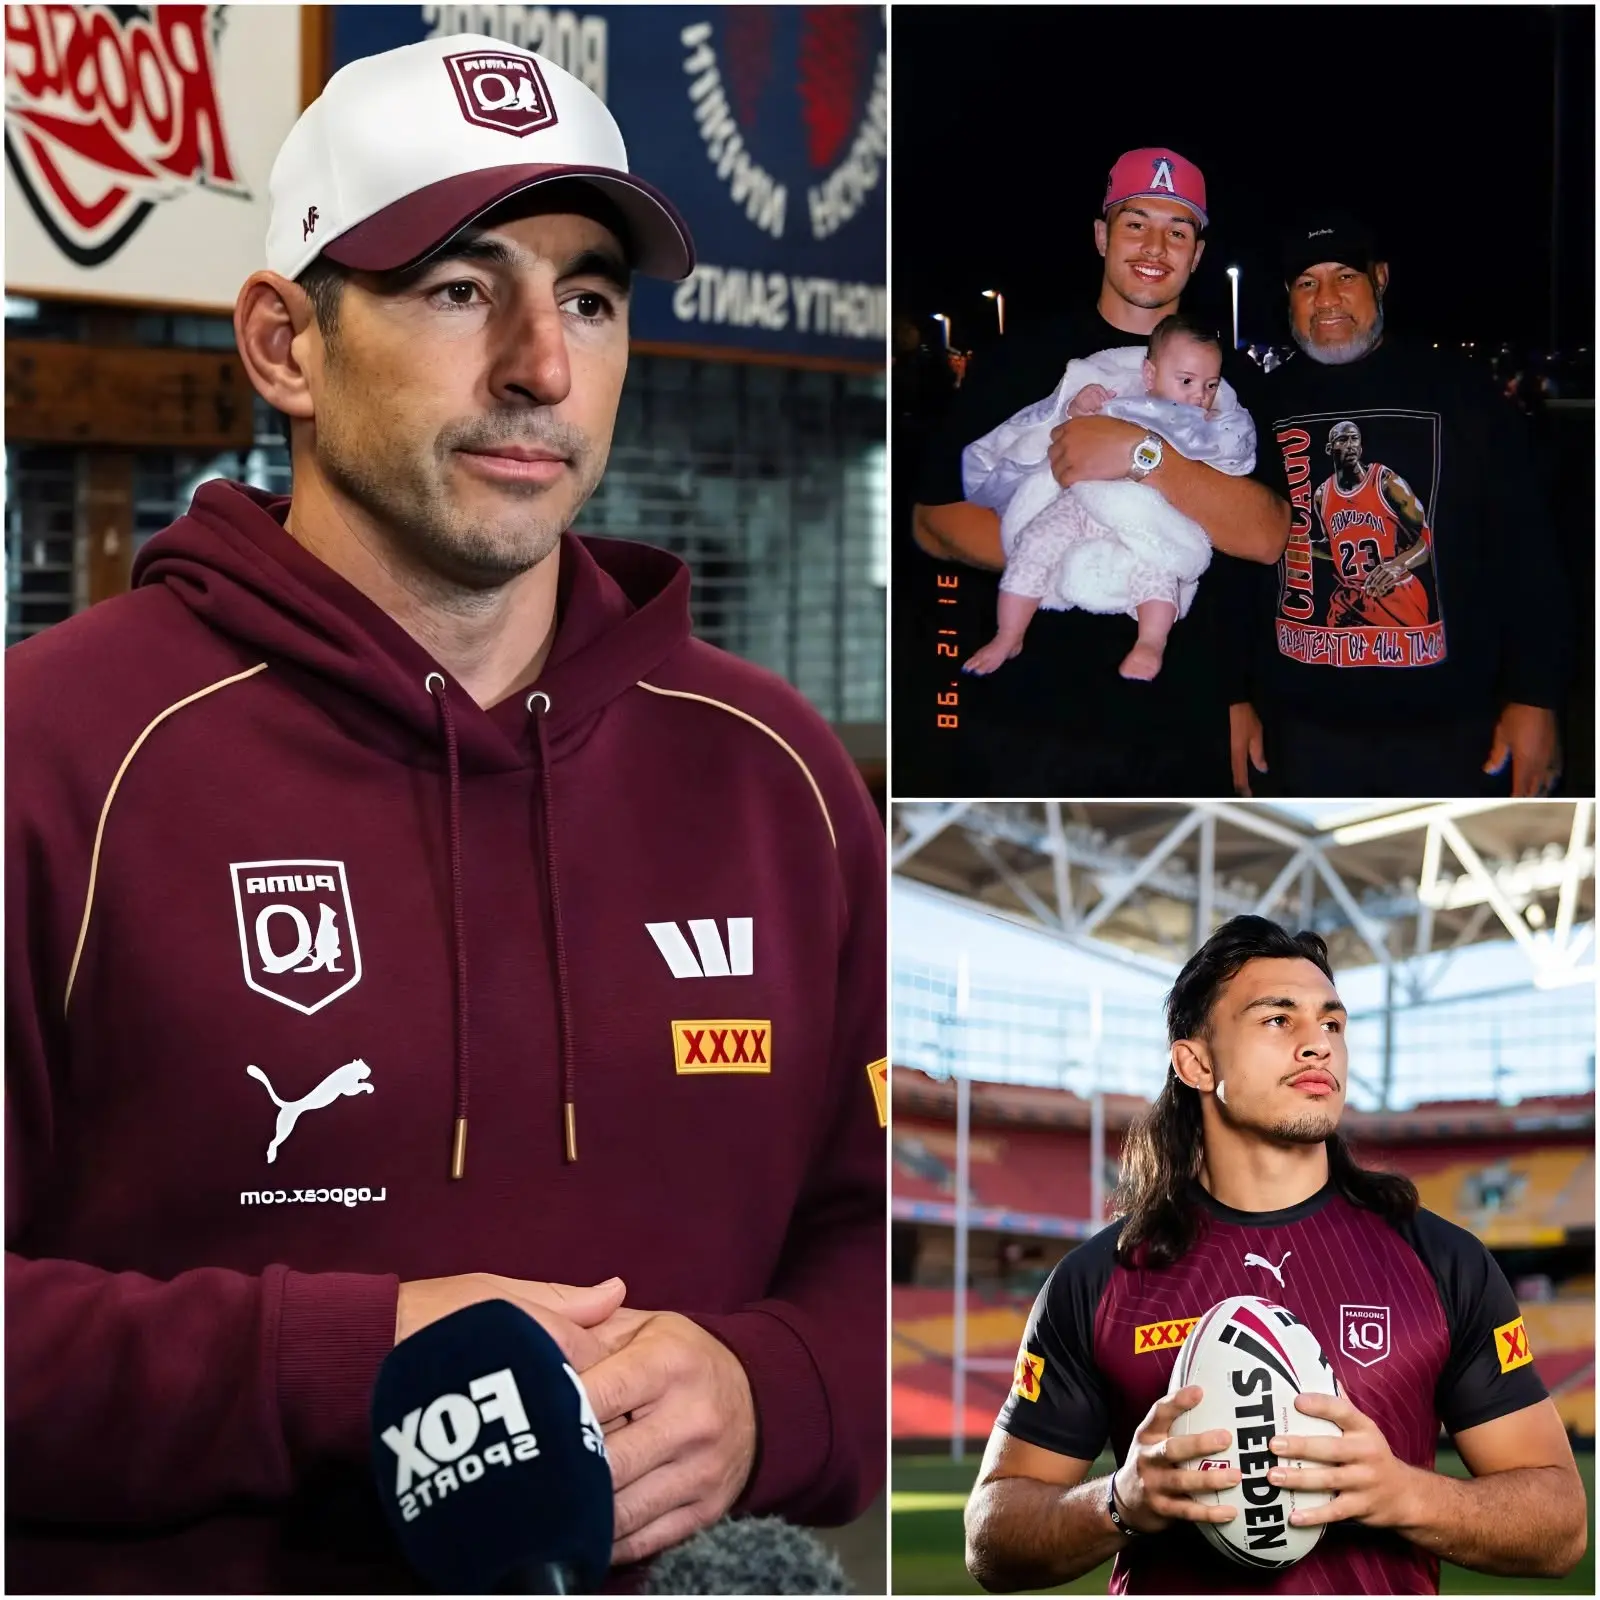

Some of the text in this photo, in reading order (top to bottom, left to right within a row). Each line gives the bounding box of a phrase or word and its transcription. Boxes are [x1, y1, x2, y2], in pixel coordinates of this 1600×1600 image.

[1150, 161, 1174, 193] A
[1338, 538, 1381, 578] 23
[1139, 1321, 1199, 1350] XXX
[1232, 1367, 1288, 1550] STEEDEN
